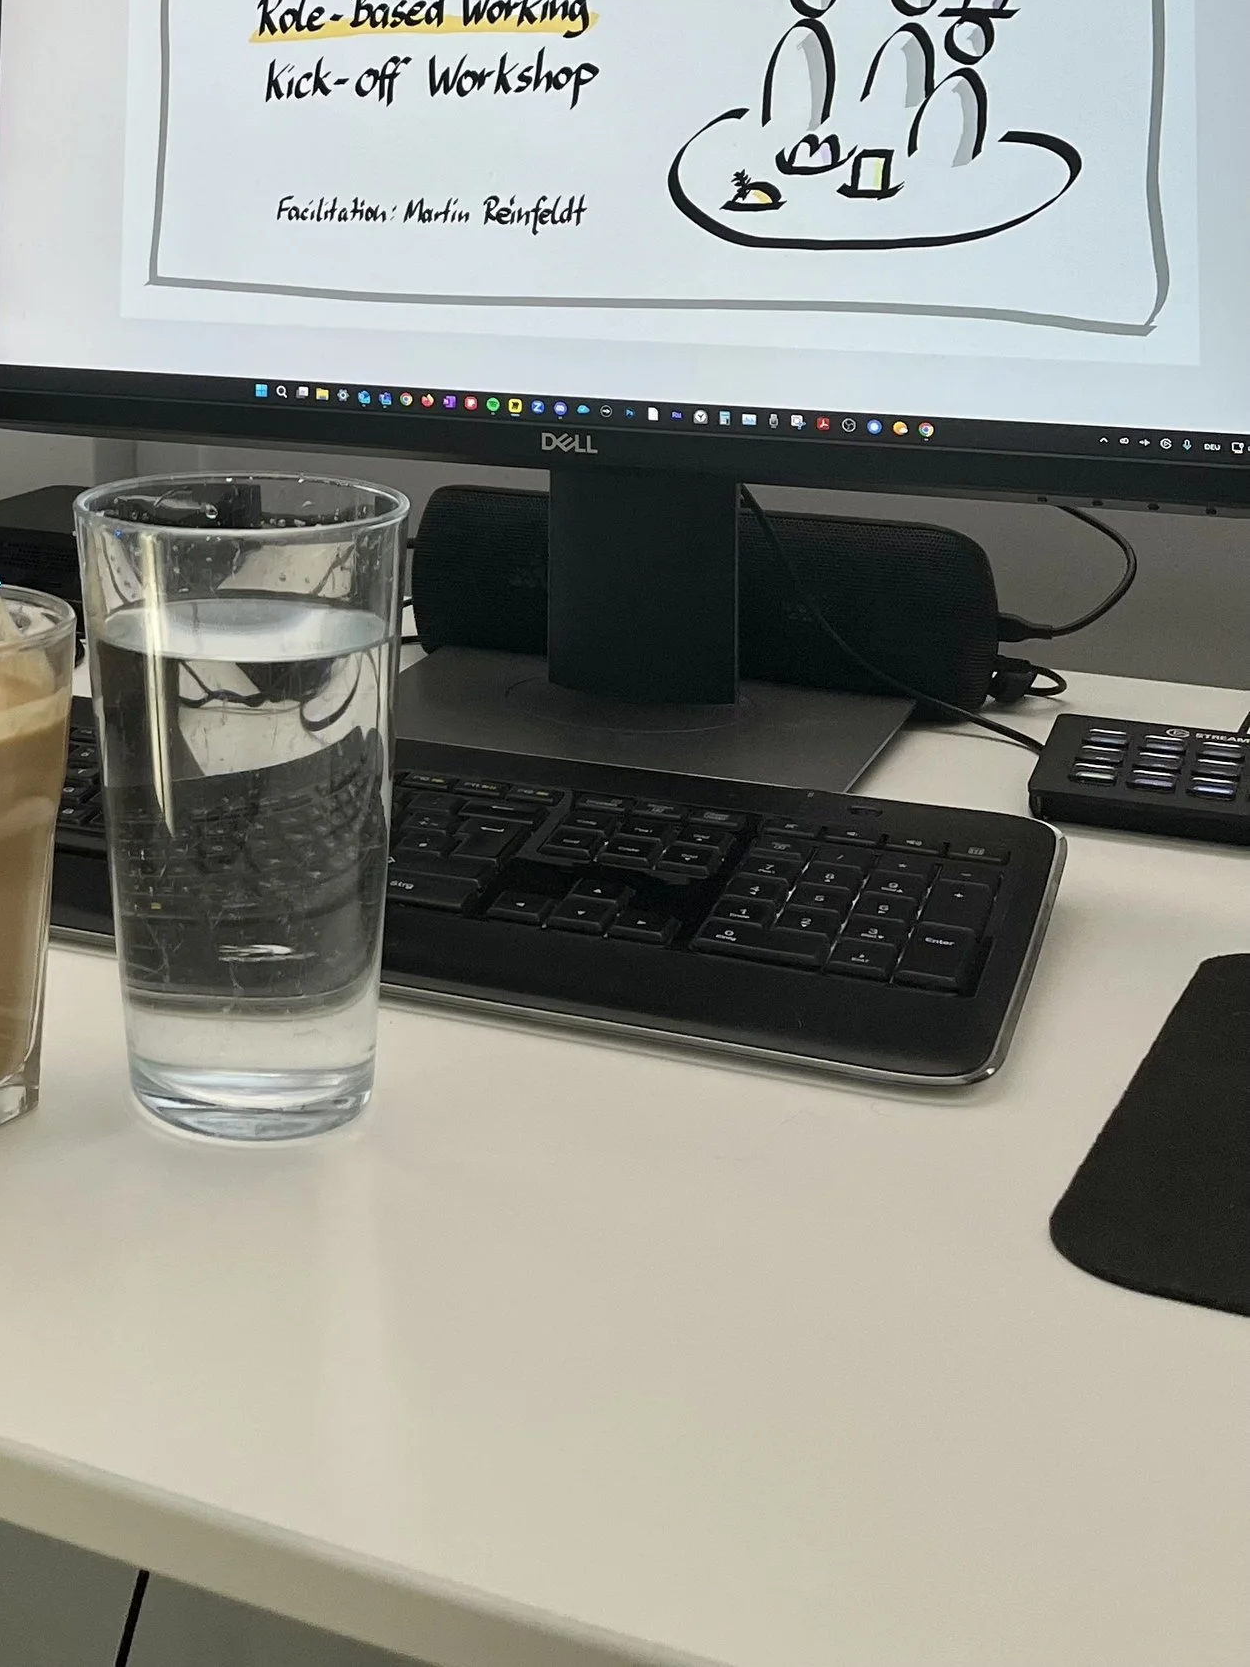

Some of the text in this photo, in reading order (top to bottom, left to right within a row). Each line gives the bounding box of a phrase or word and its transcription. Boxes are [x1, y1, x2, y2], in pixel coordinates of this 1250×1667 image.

[265, 47, 600, 110] Kick-off Workshop
[276, 194, 587, 236] Facilitation: Martin Reinfeldt
[541, 432, 598, 454] DELL
[389, 880, 414, 890] Strg
[925, 936, 955, 946] Enter
